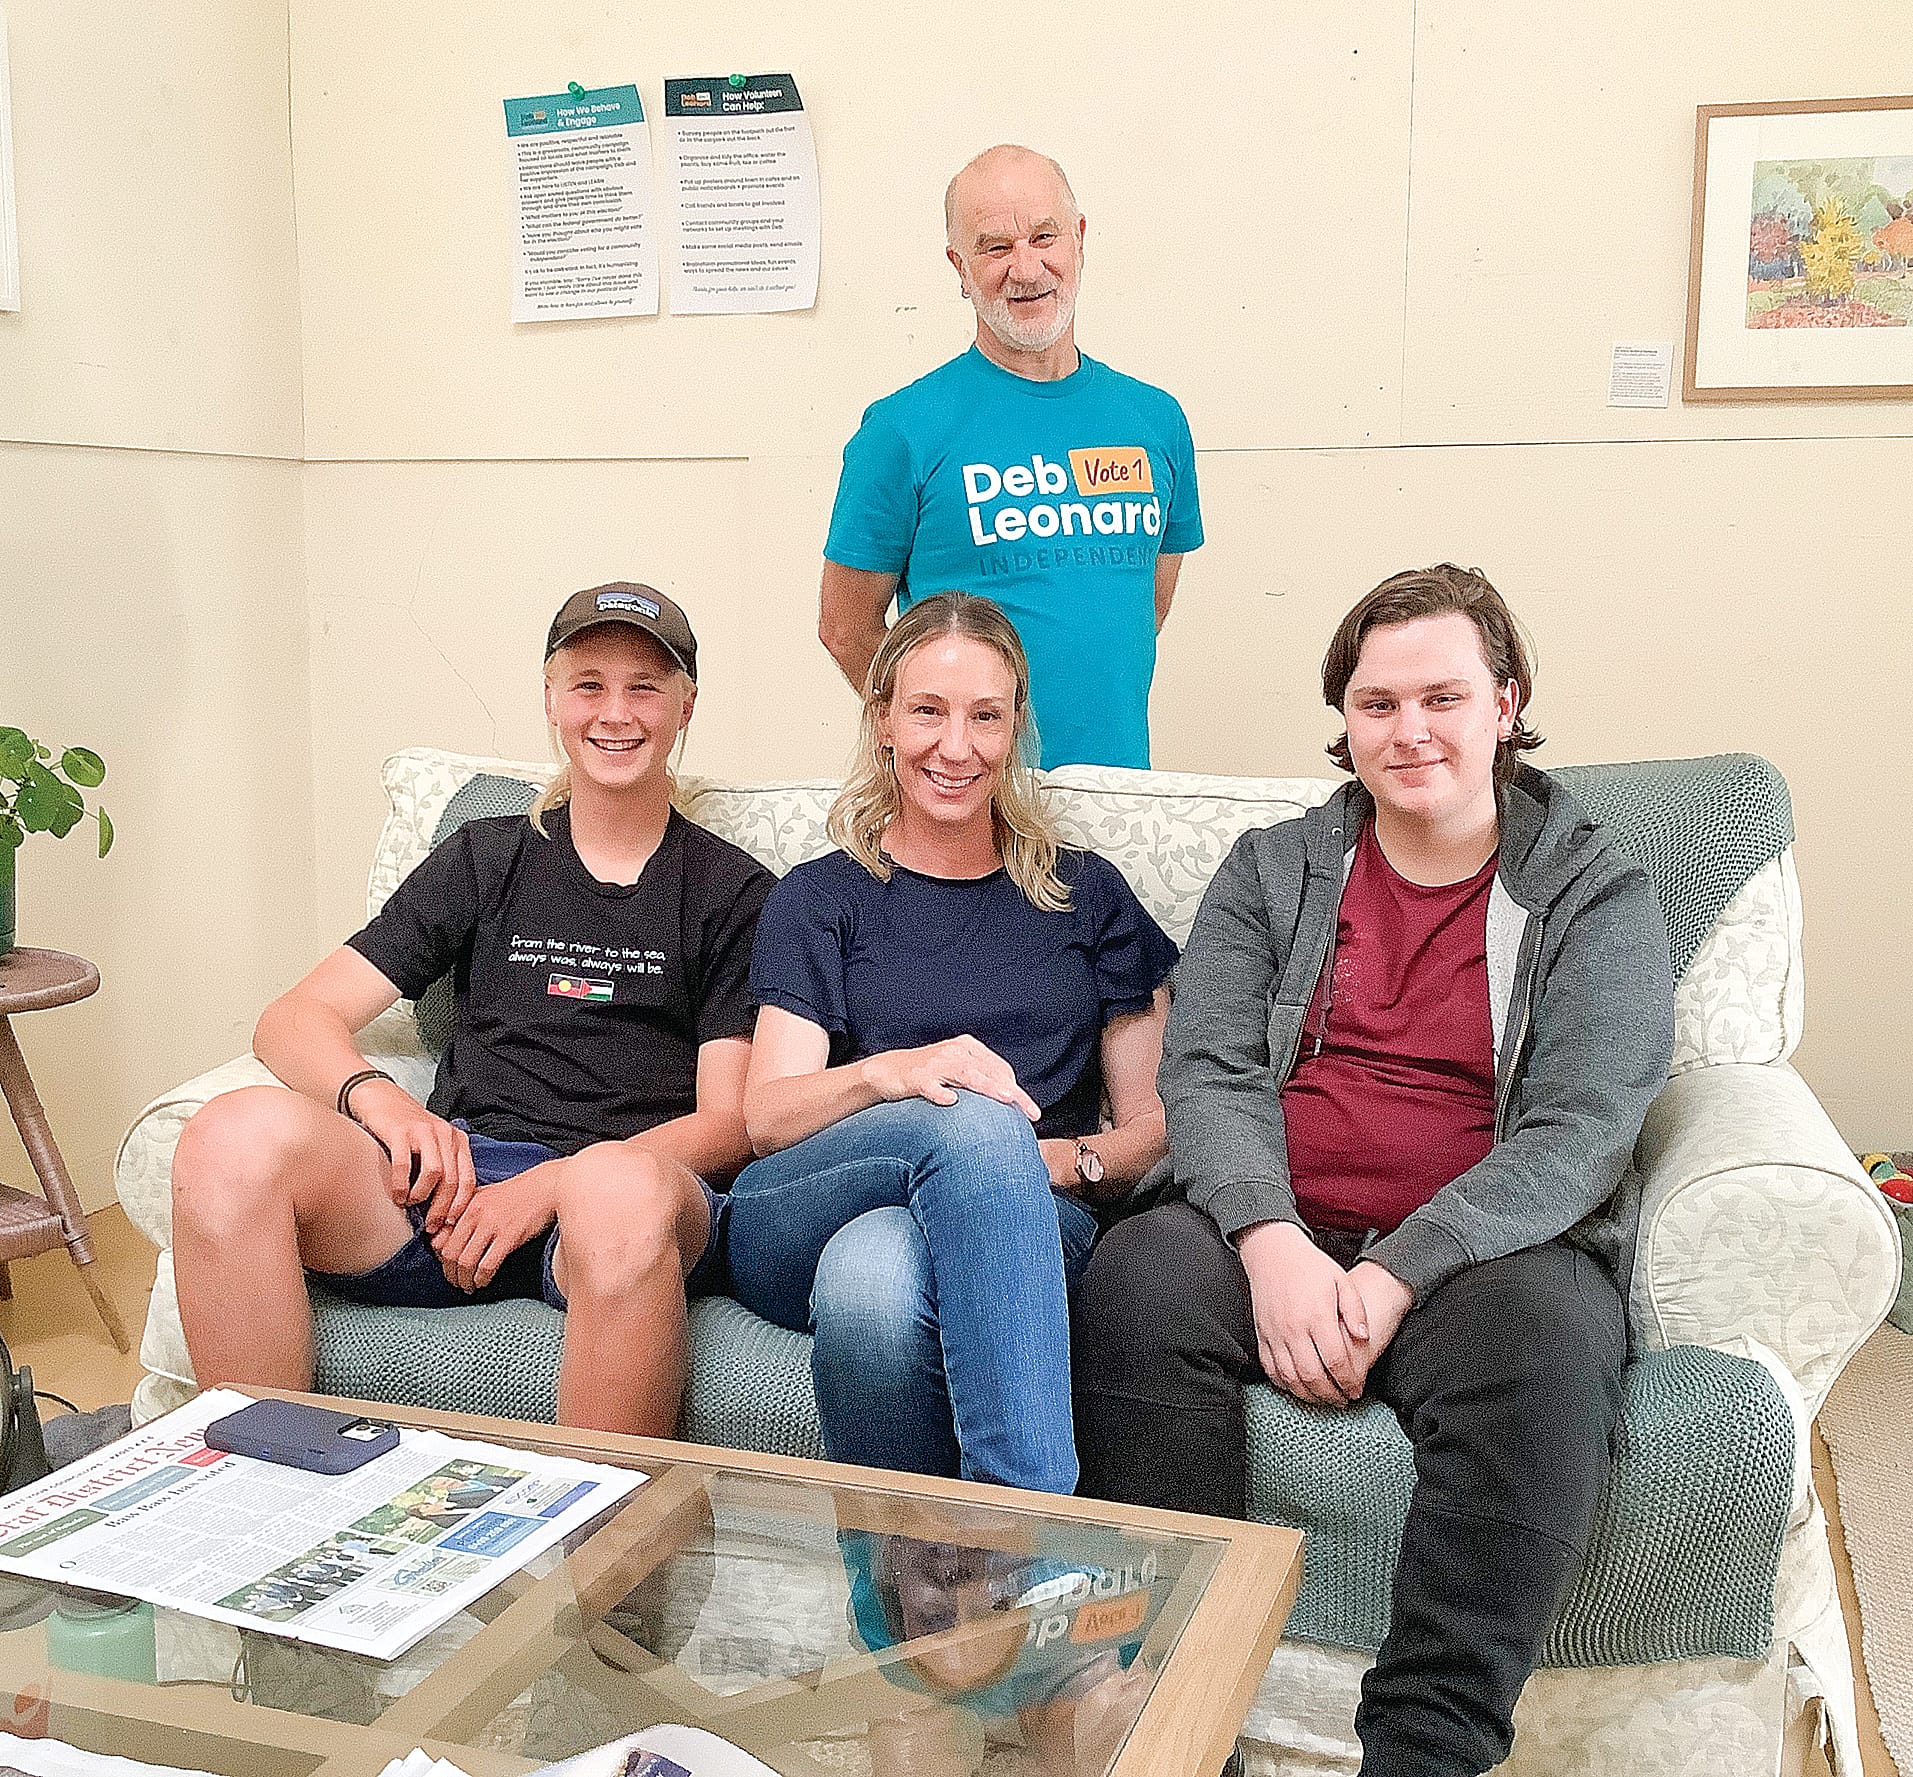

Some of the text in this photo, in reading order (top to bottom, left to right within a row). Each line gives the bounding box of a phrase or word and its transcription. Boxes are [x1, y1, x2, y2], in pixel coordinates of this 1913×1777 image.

[722, 91, 741, 100] How
[722, 102, 741, 111] Can
[742, 101, 764, 111] Help:
[557, 102, 620, 117] How We Behave
[565, 116, 596, 128] Engage
[961, 454, 1068, 504] Deb
[1084, 457, 1143, 487] Vote 1
[967, 496, 1161, 546] Leonard
[511, 934, 543, 948] from
[546, 938, 566, 950] the
[569, 941, 601, 954] river
[604, 946, 619, 958] to
[621, 948, 641, 959] the
[508, 951, 547, 967] always
[581, 957, 622, 976] always
[626, 962, 645, 974] will
[38, 1457, 159, 1508] District
[198, 1462, 236, 1481] voted
